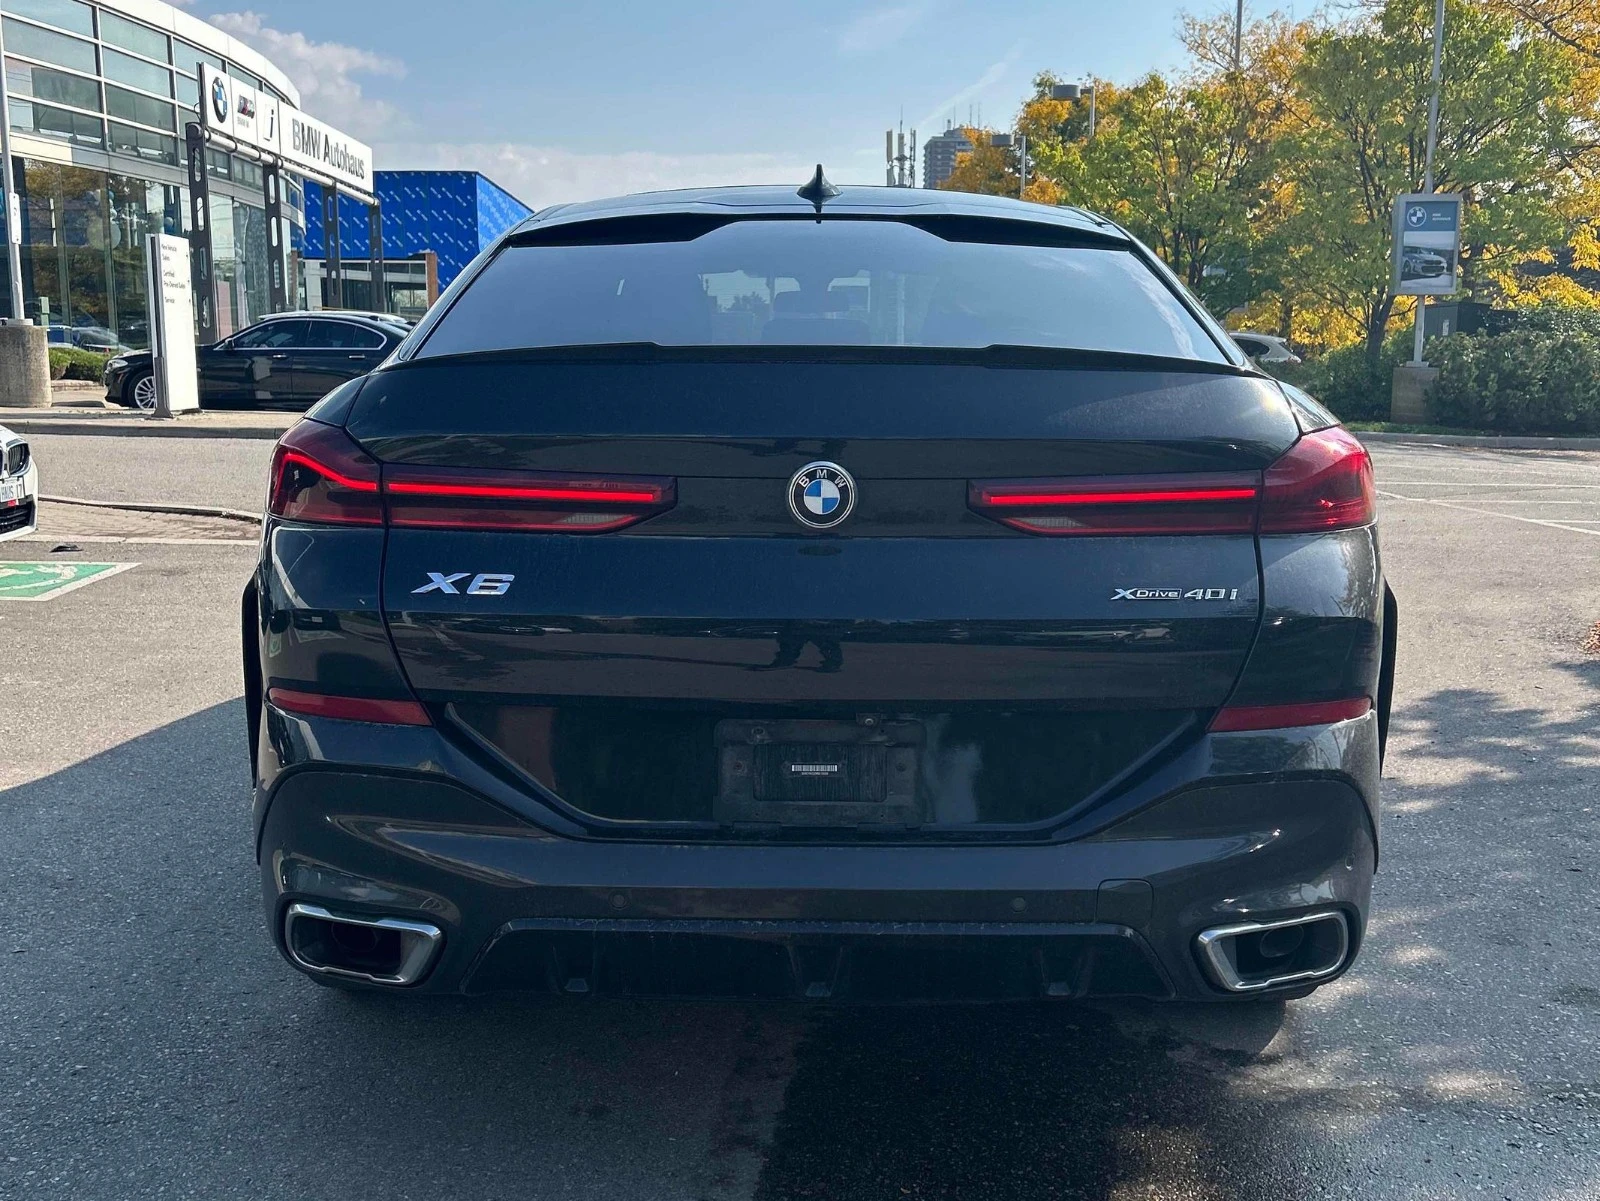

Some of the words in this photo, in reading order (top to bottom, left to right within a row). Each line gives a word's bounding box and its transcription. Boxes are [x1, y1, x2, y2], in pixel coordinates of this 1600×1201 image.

[292, 117, 321, 161] BMW
[323, 133, 365, 180] Autohaus
[798, 469, 847, 489] BMW
[410, 572, 516, 596] X6
